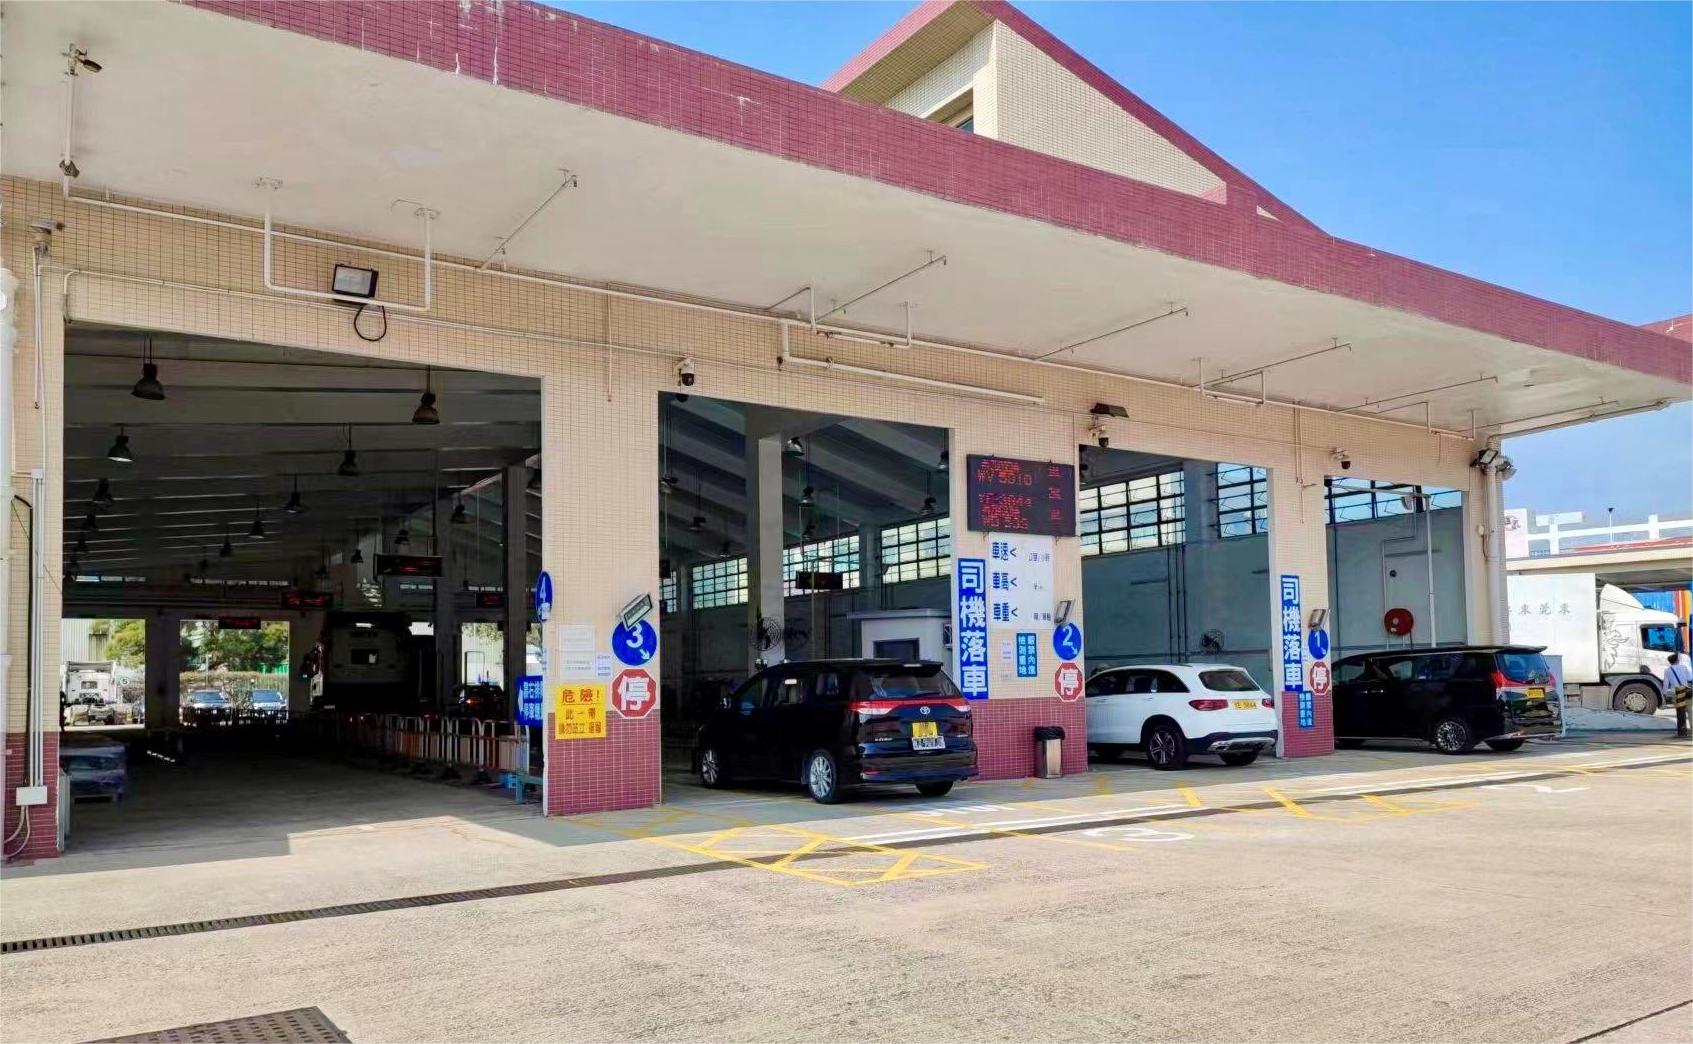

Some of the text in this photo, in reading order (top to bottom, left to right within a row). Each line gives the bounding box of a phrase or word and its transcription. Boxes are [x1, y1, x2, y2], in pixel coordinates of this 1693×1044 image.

[539, 576, 547, 603] 4
[625, 622, 644, 649] 3
[959, 561, 988, 697] 司機落車
[1062, 626, 1074, 647] 2
[1281, 577, 1302, 690] 司機落車
[1314, 631, 1321, 648] 1
[617, 674, 651, 711] 停
